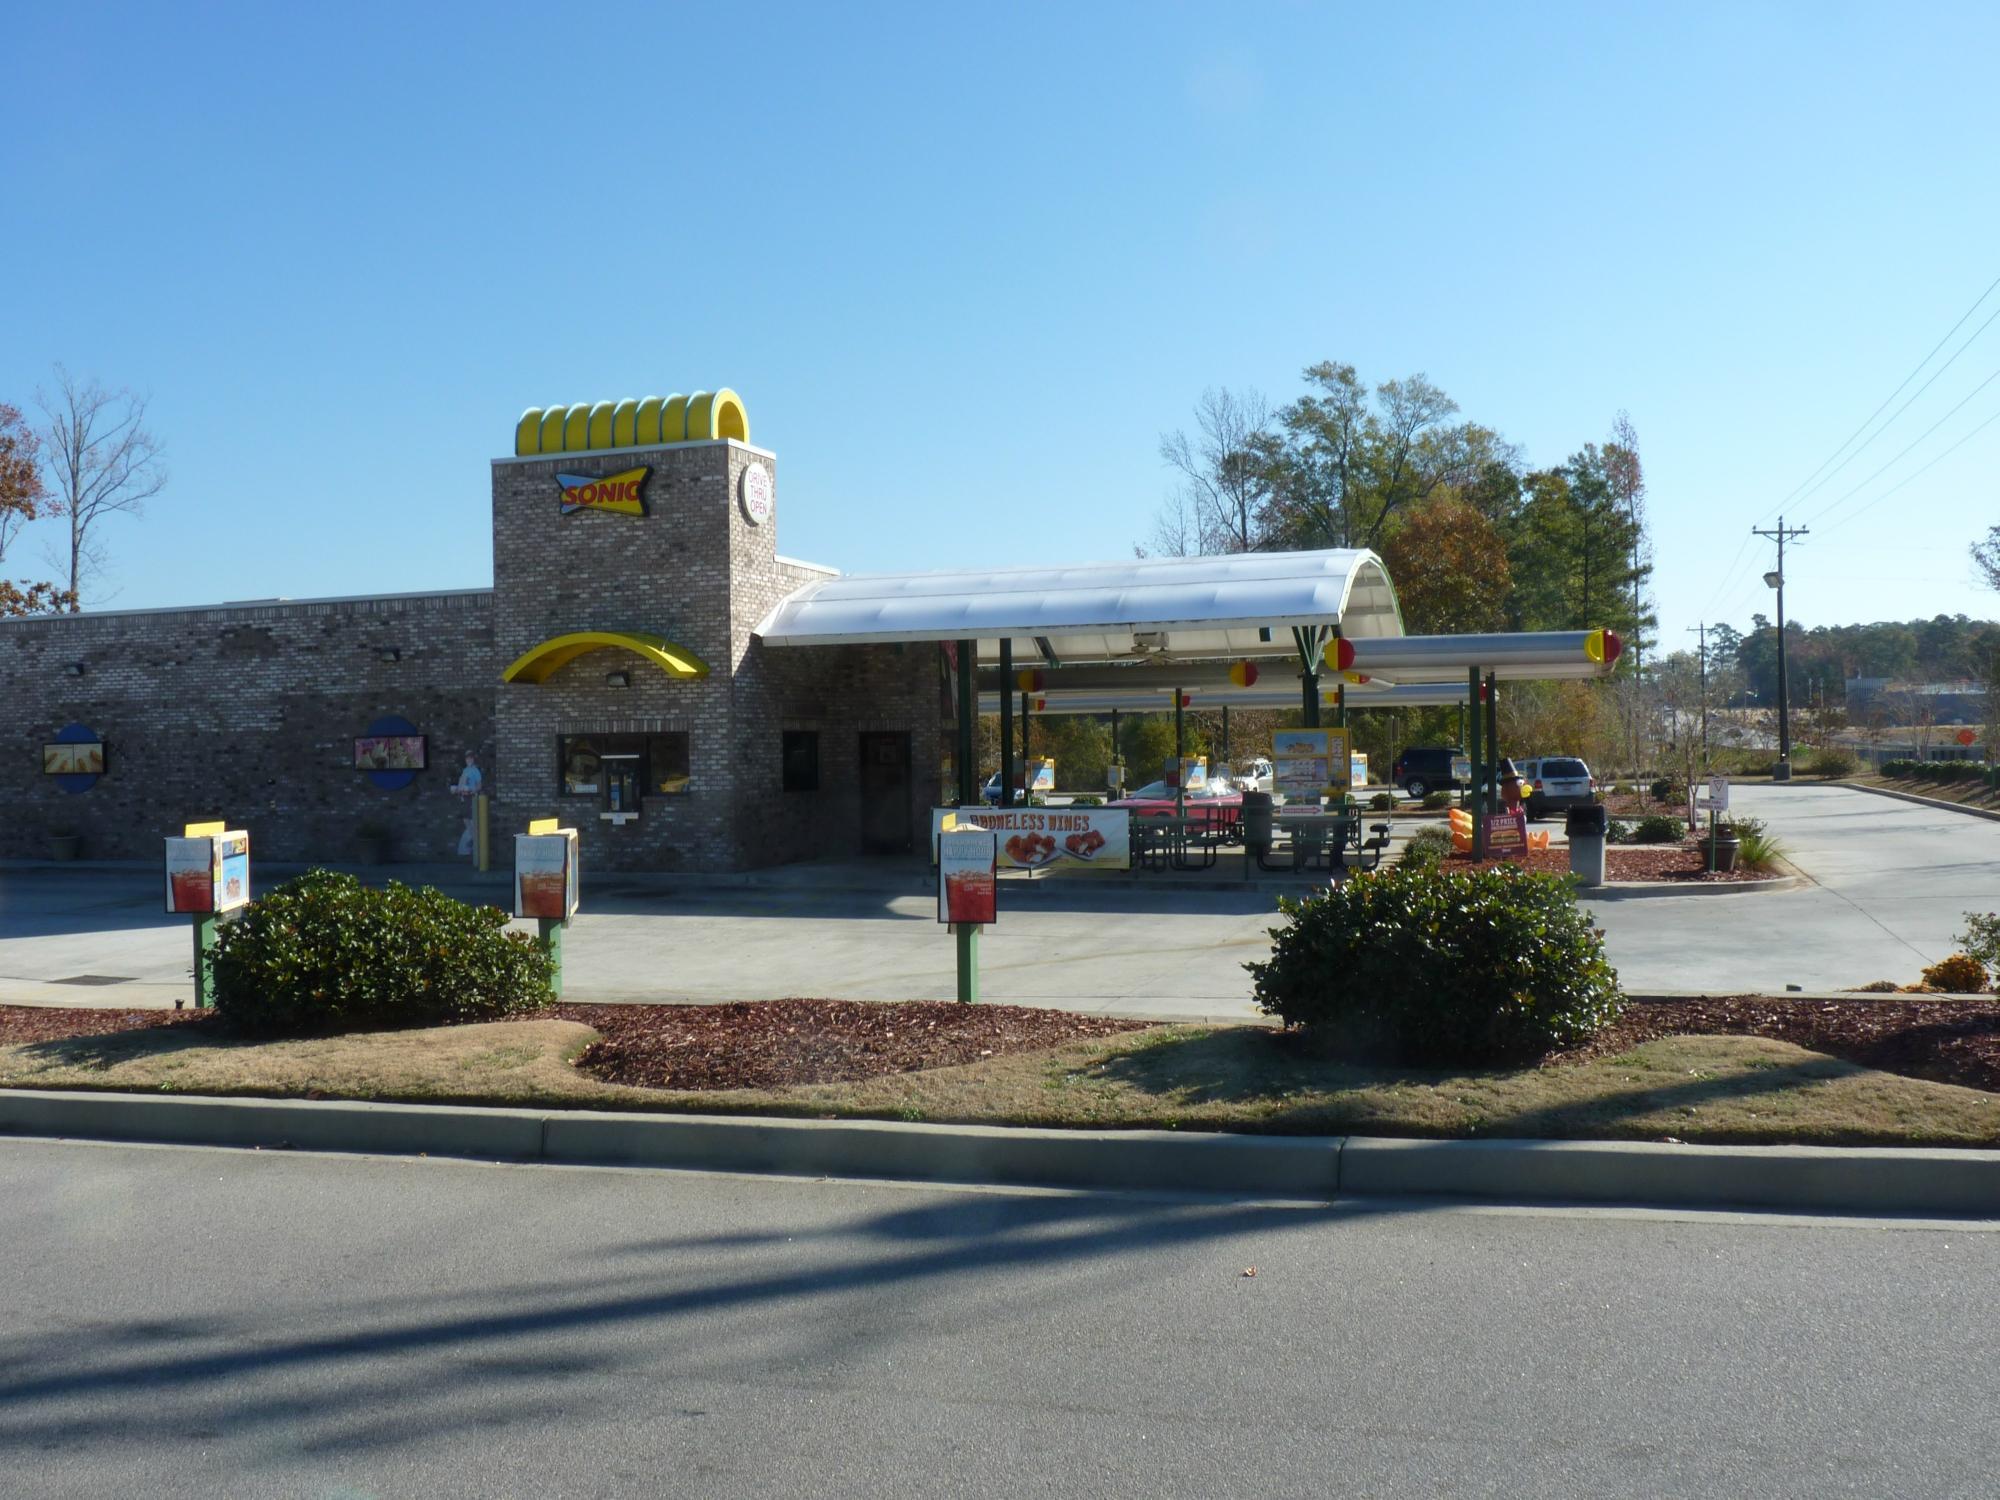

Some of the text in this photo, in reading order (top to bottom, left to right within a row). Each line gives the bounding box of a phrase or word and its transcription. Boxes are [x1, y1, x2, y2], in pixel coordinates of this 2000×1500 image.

[748, 471, 768, 487] DRIVE
[564, 480, 641, 505] SONIC
[750, 485, 767, 501] THRU
[750, 500, 768, 514] OPEN
[1048, 814, 1090, 832] WINGS
